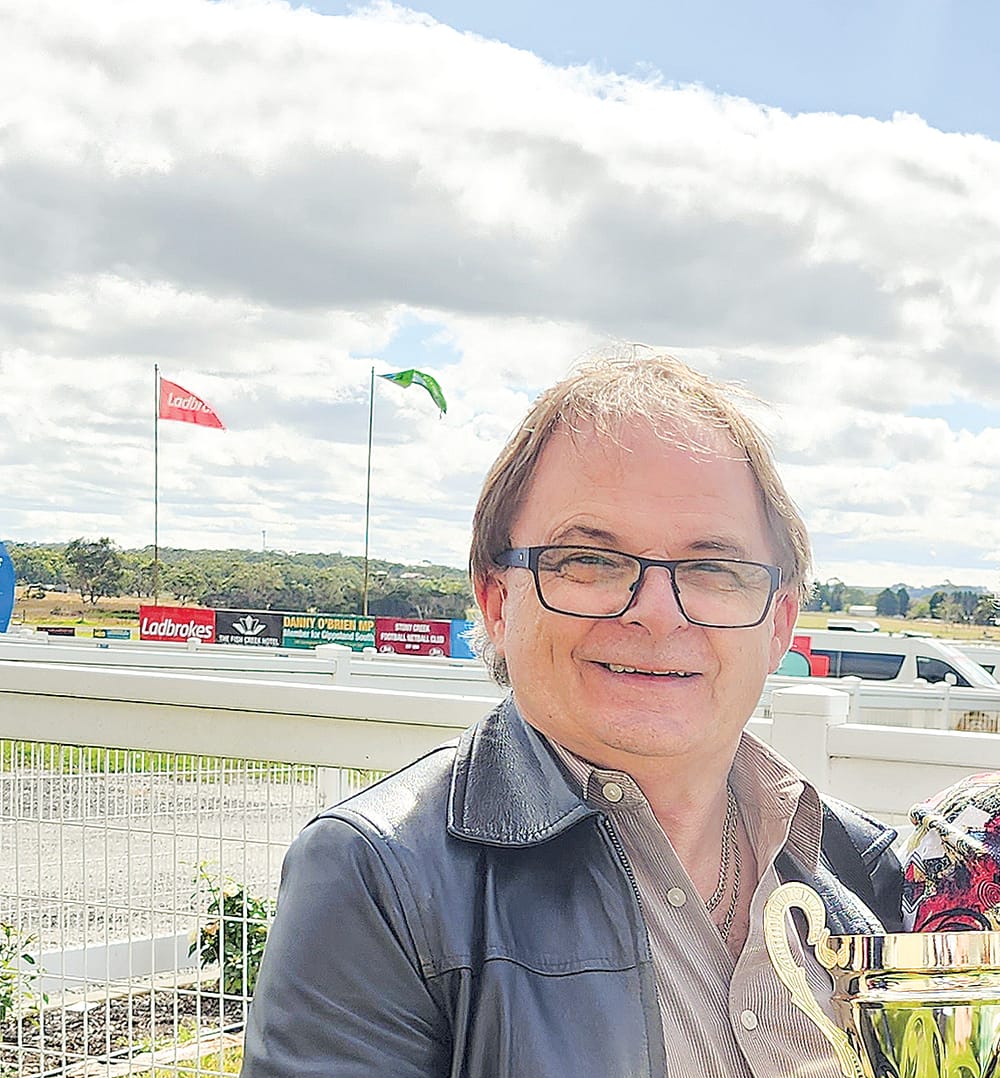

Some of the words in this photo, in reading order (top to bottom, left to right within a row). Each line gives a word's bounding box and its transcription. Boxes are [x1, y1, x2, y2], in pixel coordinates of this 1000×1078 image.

[141, 617, 214, 639] Ladbrokes
[283, 617, 315, 629] DANNY
[318, 618, 357, 631] O'BRIEN
[358, 619, 375, 632] MP
[230, 635, 243, 643] FISH
[244, 636, 261, 644] CREEK
[262, 638, 279, 646] HOTEL
[283, 629, 310, 638] Member
[311, 630, 320, 638] for
[321, 631, 354, 641] Gippsland
[355, 632, 374, 642] South
